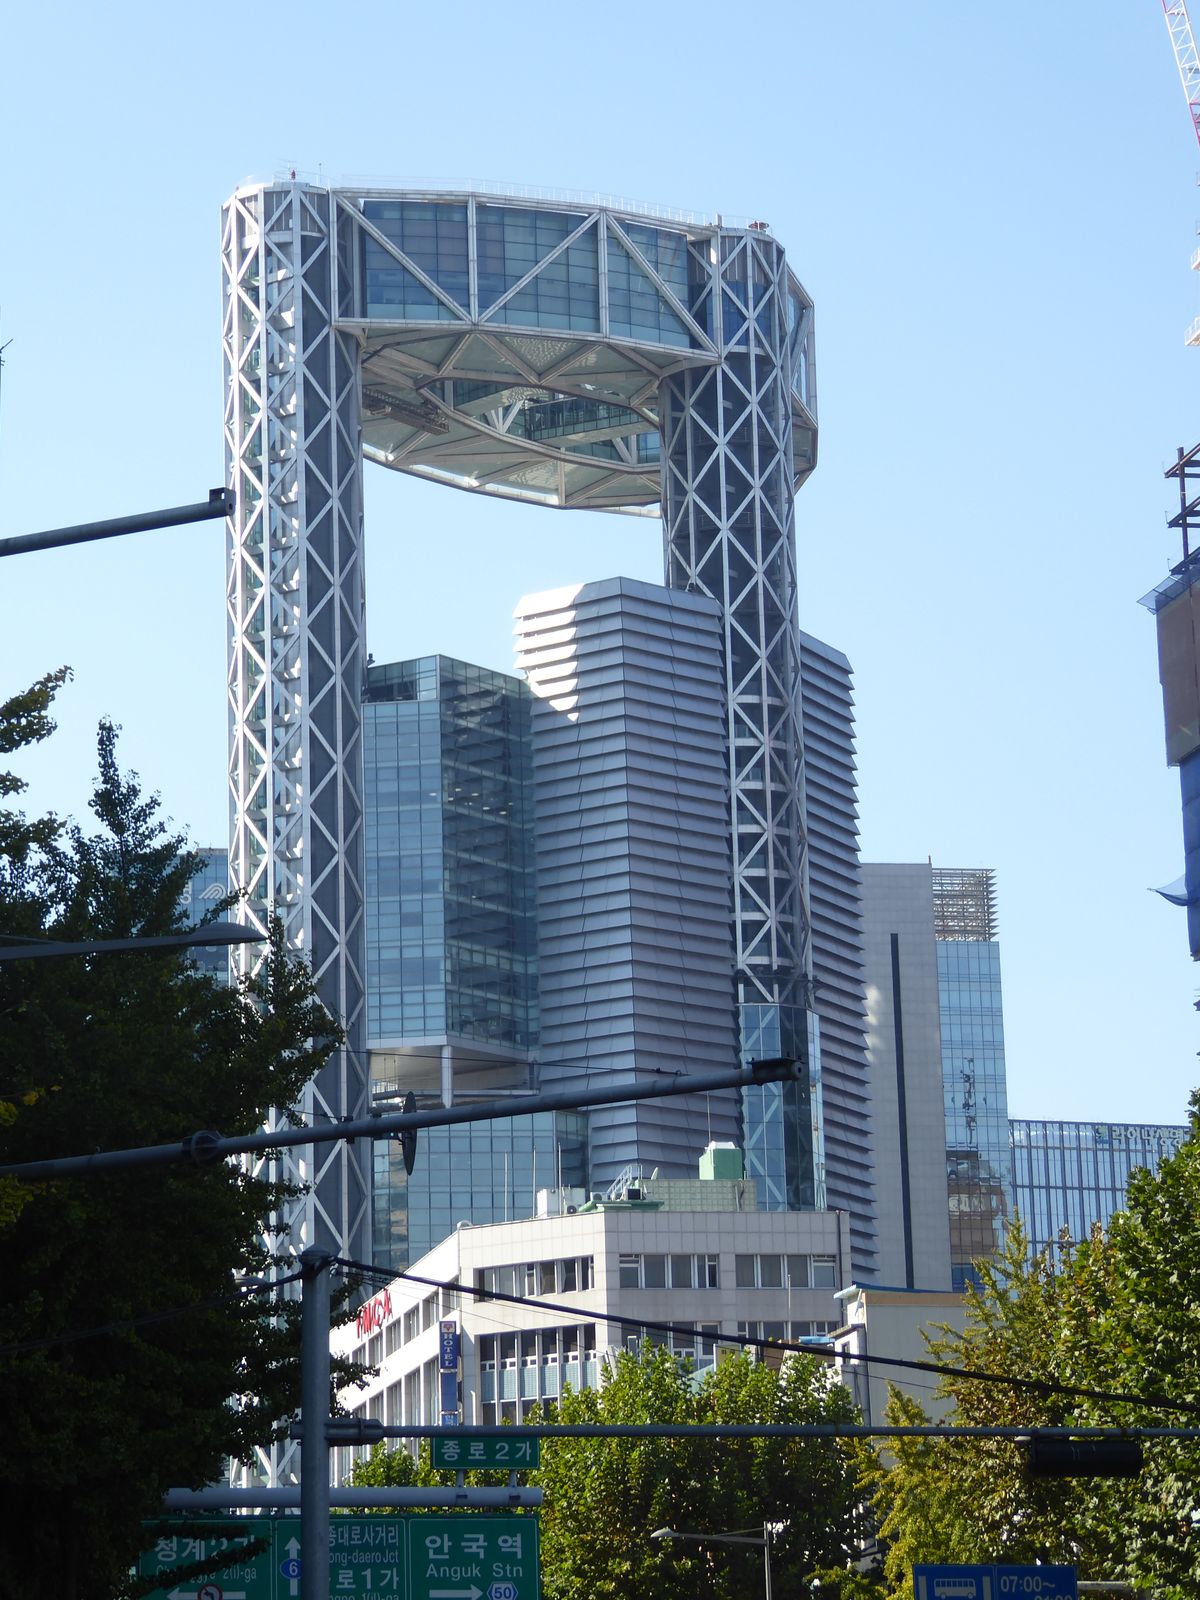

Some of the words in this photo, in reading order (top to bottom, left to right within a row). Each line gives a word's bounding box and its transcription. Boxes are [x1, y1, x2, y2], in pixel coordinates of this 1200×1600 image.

[443, 1333, 454, 1367] HOTEL
[441, 1440, 532, 1461] 종로2가
[383, 1549, 400, 1564] Jct
[425, 1533, 522, 1560] 안국역
[289, 1562, 298, 1576] 6
[328, 1567, 400, 1590] 로1가
[426, 1563, 482, 1582] Anguk
[492, 1563, 523, 1578] Stn
[494, 1587, 511, 1599] 50
